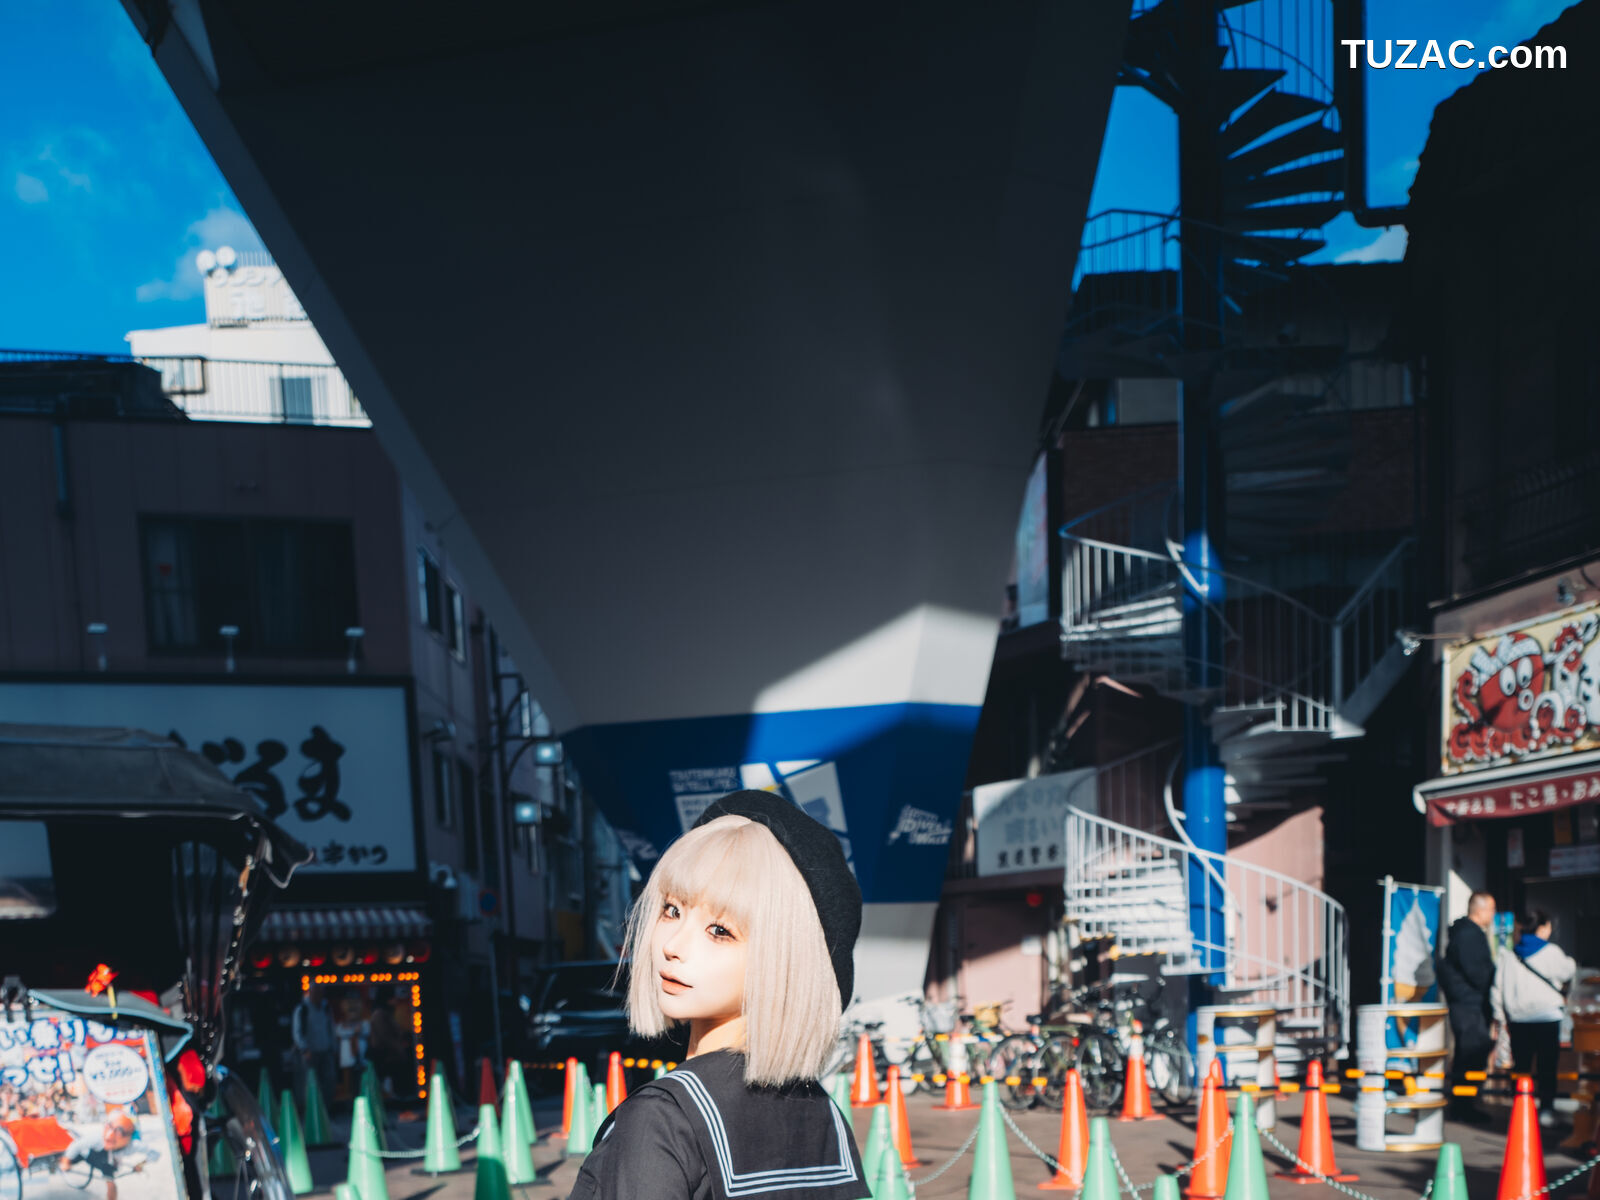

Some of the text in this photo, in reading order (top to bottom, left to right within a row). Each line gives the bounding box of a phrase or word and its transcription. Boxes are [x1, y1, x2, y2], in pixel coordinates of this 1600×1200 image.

[167, 725, 352, 822] るま
[312, 839, 388, 866] 串かつ
